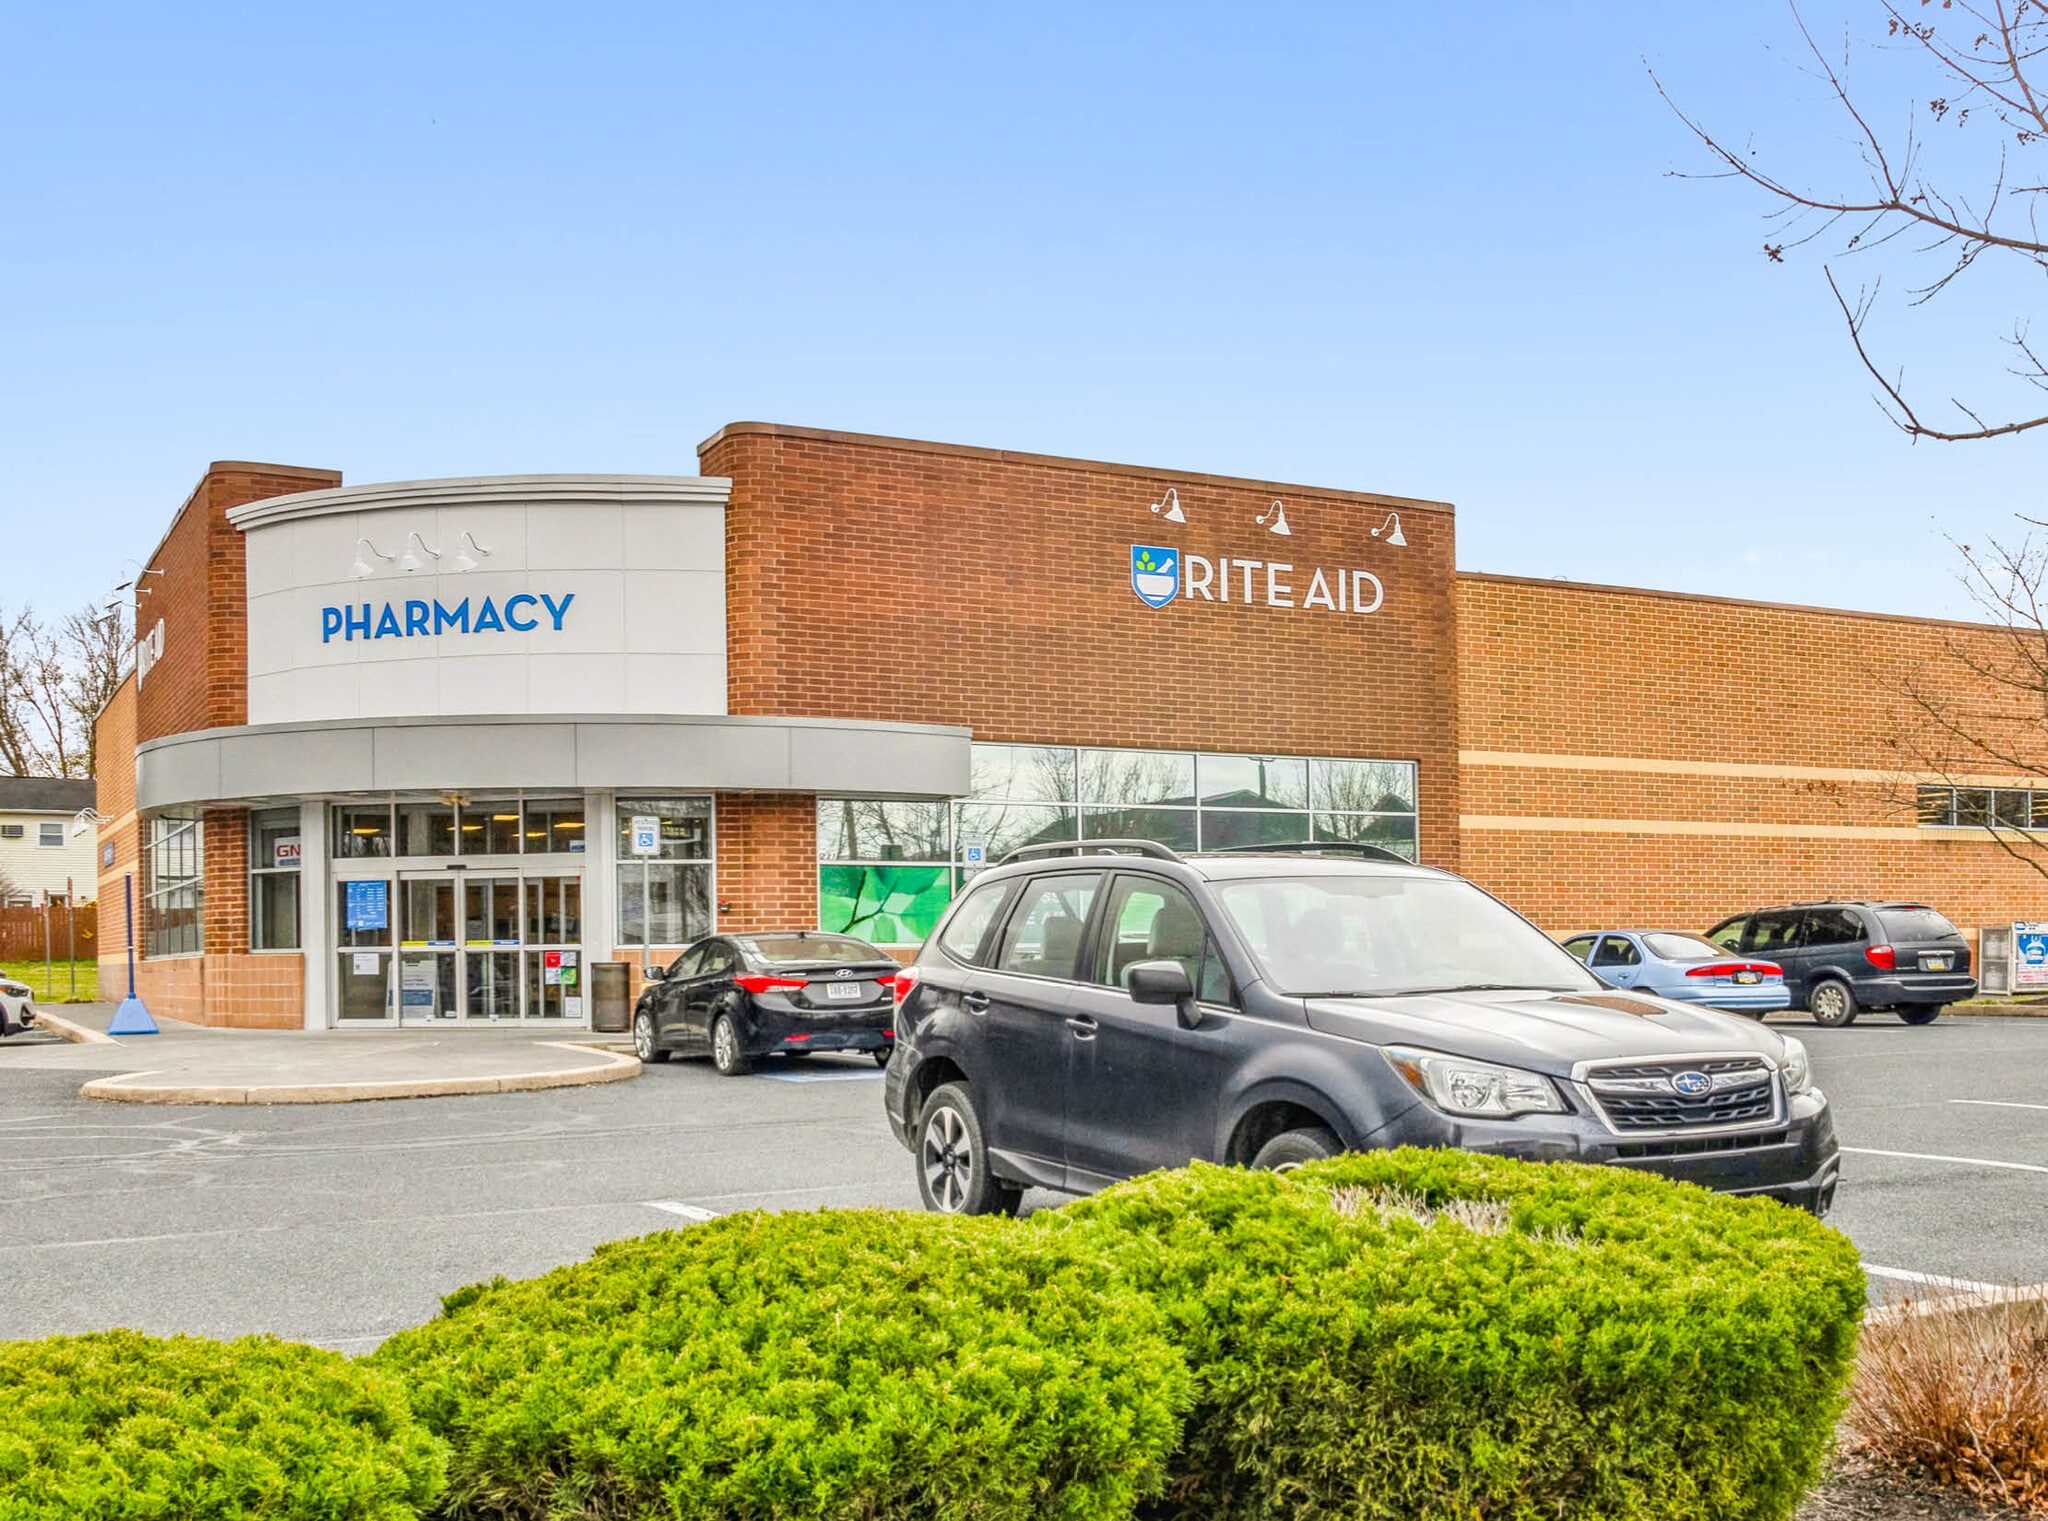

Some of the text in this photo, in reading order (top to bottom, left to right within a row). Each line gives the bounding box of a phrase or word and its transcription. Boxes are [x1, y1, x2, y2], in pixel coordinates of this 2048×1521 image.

[1184, 554, 1384, 614] RITE AID
[322, 593, 576, 644] PHARMACY
